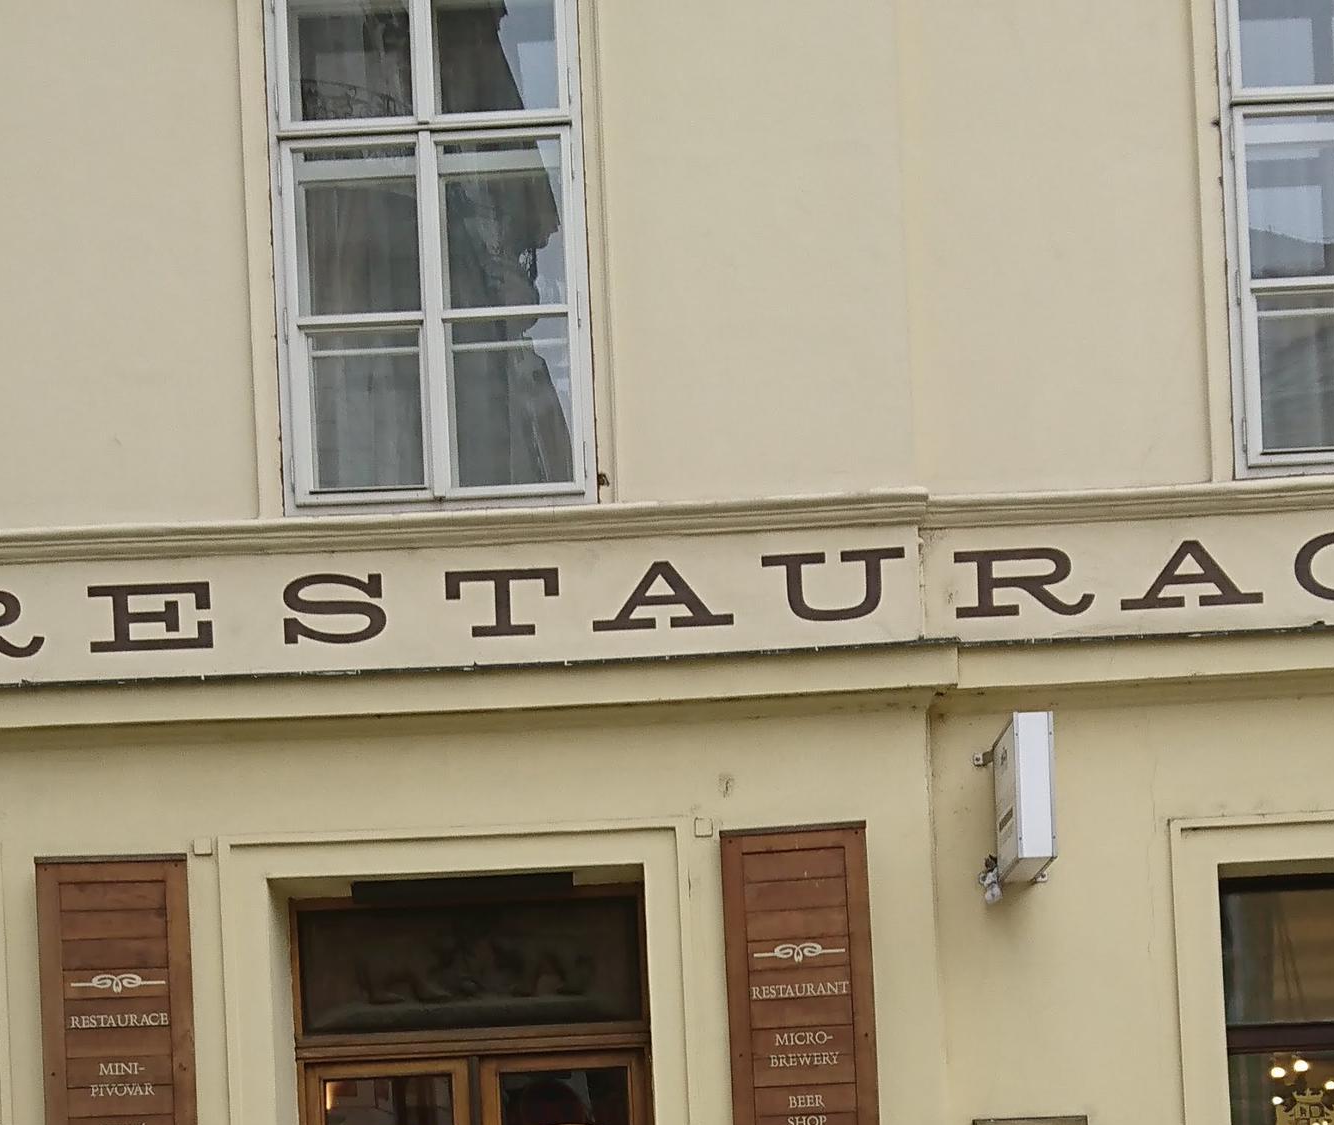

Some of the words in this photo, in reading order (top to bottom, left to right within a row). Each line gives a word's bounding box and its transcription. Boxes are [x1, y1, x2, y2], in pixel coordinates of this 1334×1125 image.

[751, 981, 849, 999] RESTAURANT
[71, 1012, 169, 1029] RESTAURACE
[775, 1031, 833, 1046] MICRO-
[770, 1052, 840, 1067] BREWERY
[99, 1062, 145, 1076] MINI-
[91, 1083, 155, 1097] PIVOVAR
[788, 1094, 825, 1108] BEER
